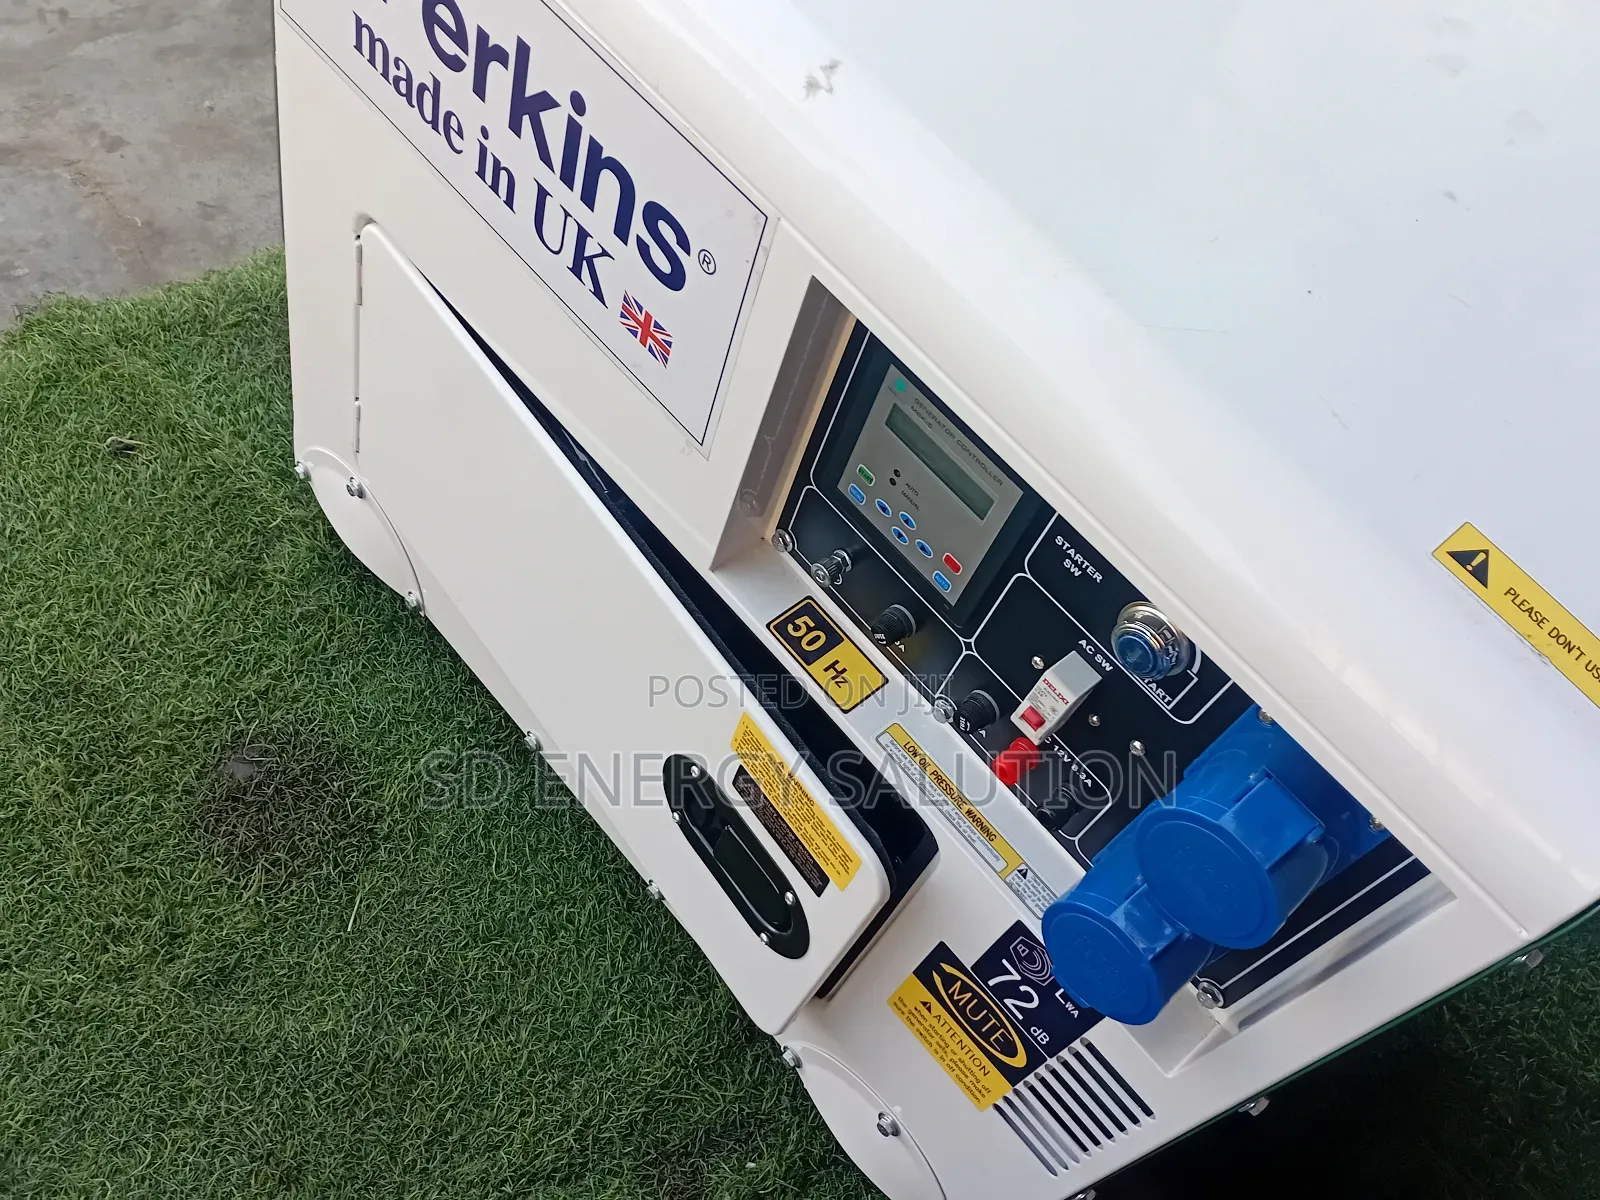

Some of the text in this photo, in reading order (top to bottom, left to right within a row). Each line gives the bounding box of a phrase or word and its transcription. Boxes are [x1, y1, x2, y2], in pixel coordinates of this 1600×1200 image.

[352, 10, 615, 310] made in UK
[384, 0, 691, 292] erkins
[913, 396, 1003, 487] GENERATOR CONTROLLER
[934, 574, 949, 590] AUTO
[1055, 535, 1103, 584] STARTER
[1063, 558, 1083, 577] SW
[786, 615, 849, 689] 50 Hz
[1078, 639, 1114, 672] AC SW
[1503, 586, 1550, 630] PLEASE
[1547, 626, 1587, 662] DON'T
[1042, 677, 1070, 706] DELIXI
[1143, 678, 1173, 703] TART
[1053, 744, 1072, 763] 12V
[902, 741, 997, 842] LOW OIL PRESSURE WARNING
[948, 980, 1013, 1052] MUTE
[987, 958, 1040, 1021] 72
[892, 1000, 983, 1104] sure the switch is in off condition.
[897, 996, 908, 1008] the
[907, 1008, 935, 1040] generator
[949, 1057, 969, 1079] please
[969, 1079, 986, 1098] make
[913, 1005, 991, 1094] when starting or shutting off
[933, 1013, 991, 1077] ATTENTION
[1030, 1025, 1050, 1046] dB
